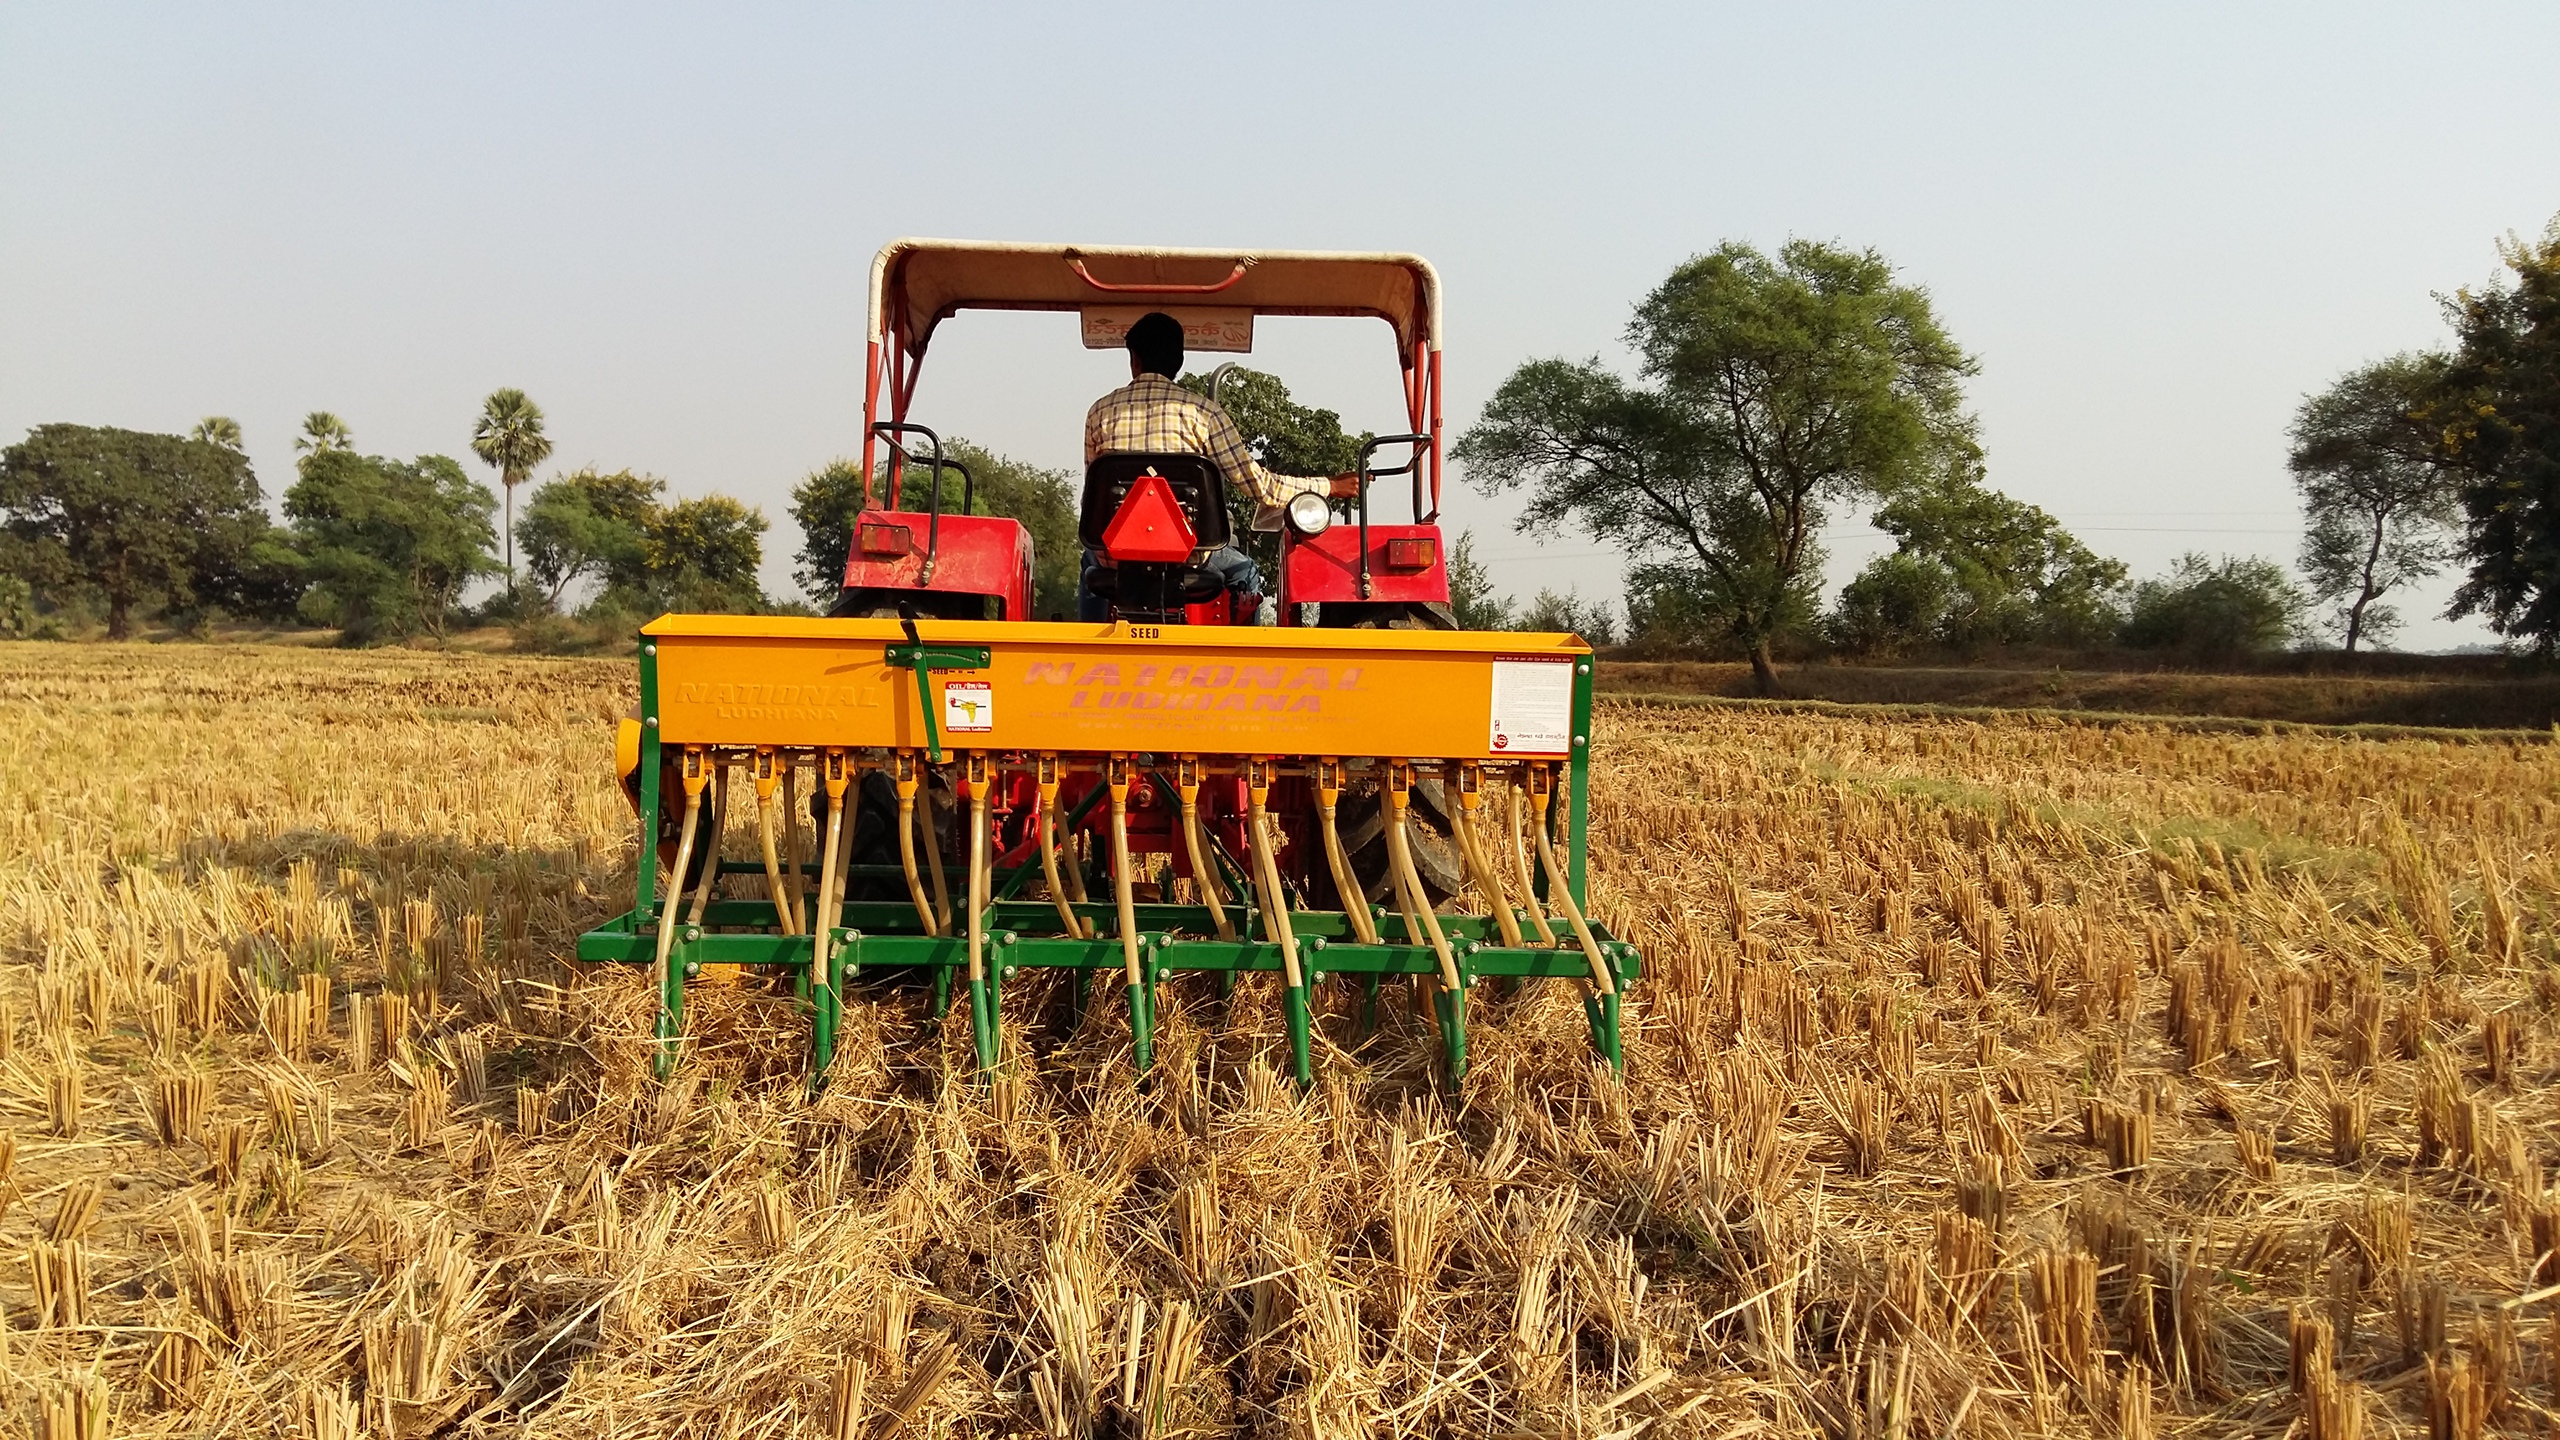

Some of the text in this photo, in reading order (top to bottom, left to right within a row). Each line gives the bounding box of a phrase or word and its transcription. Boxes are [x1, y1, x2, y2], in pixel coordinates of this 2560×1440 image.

[1130, 627, 1160, 639] SEED
[1022, 661, 1369, 691] NATIONAL
[674, 682, 880, 708] NATIONAL
[1068, 690, 1322, 713] LUDHIANA
[716, 706, 839, 721] LUDHIANA
